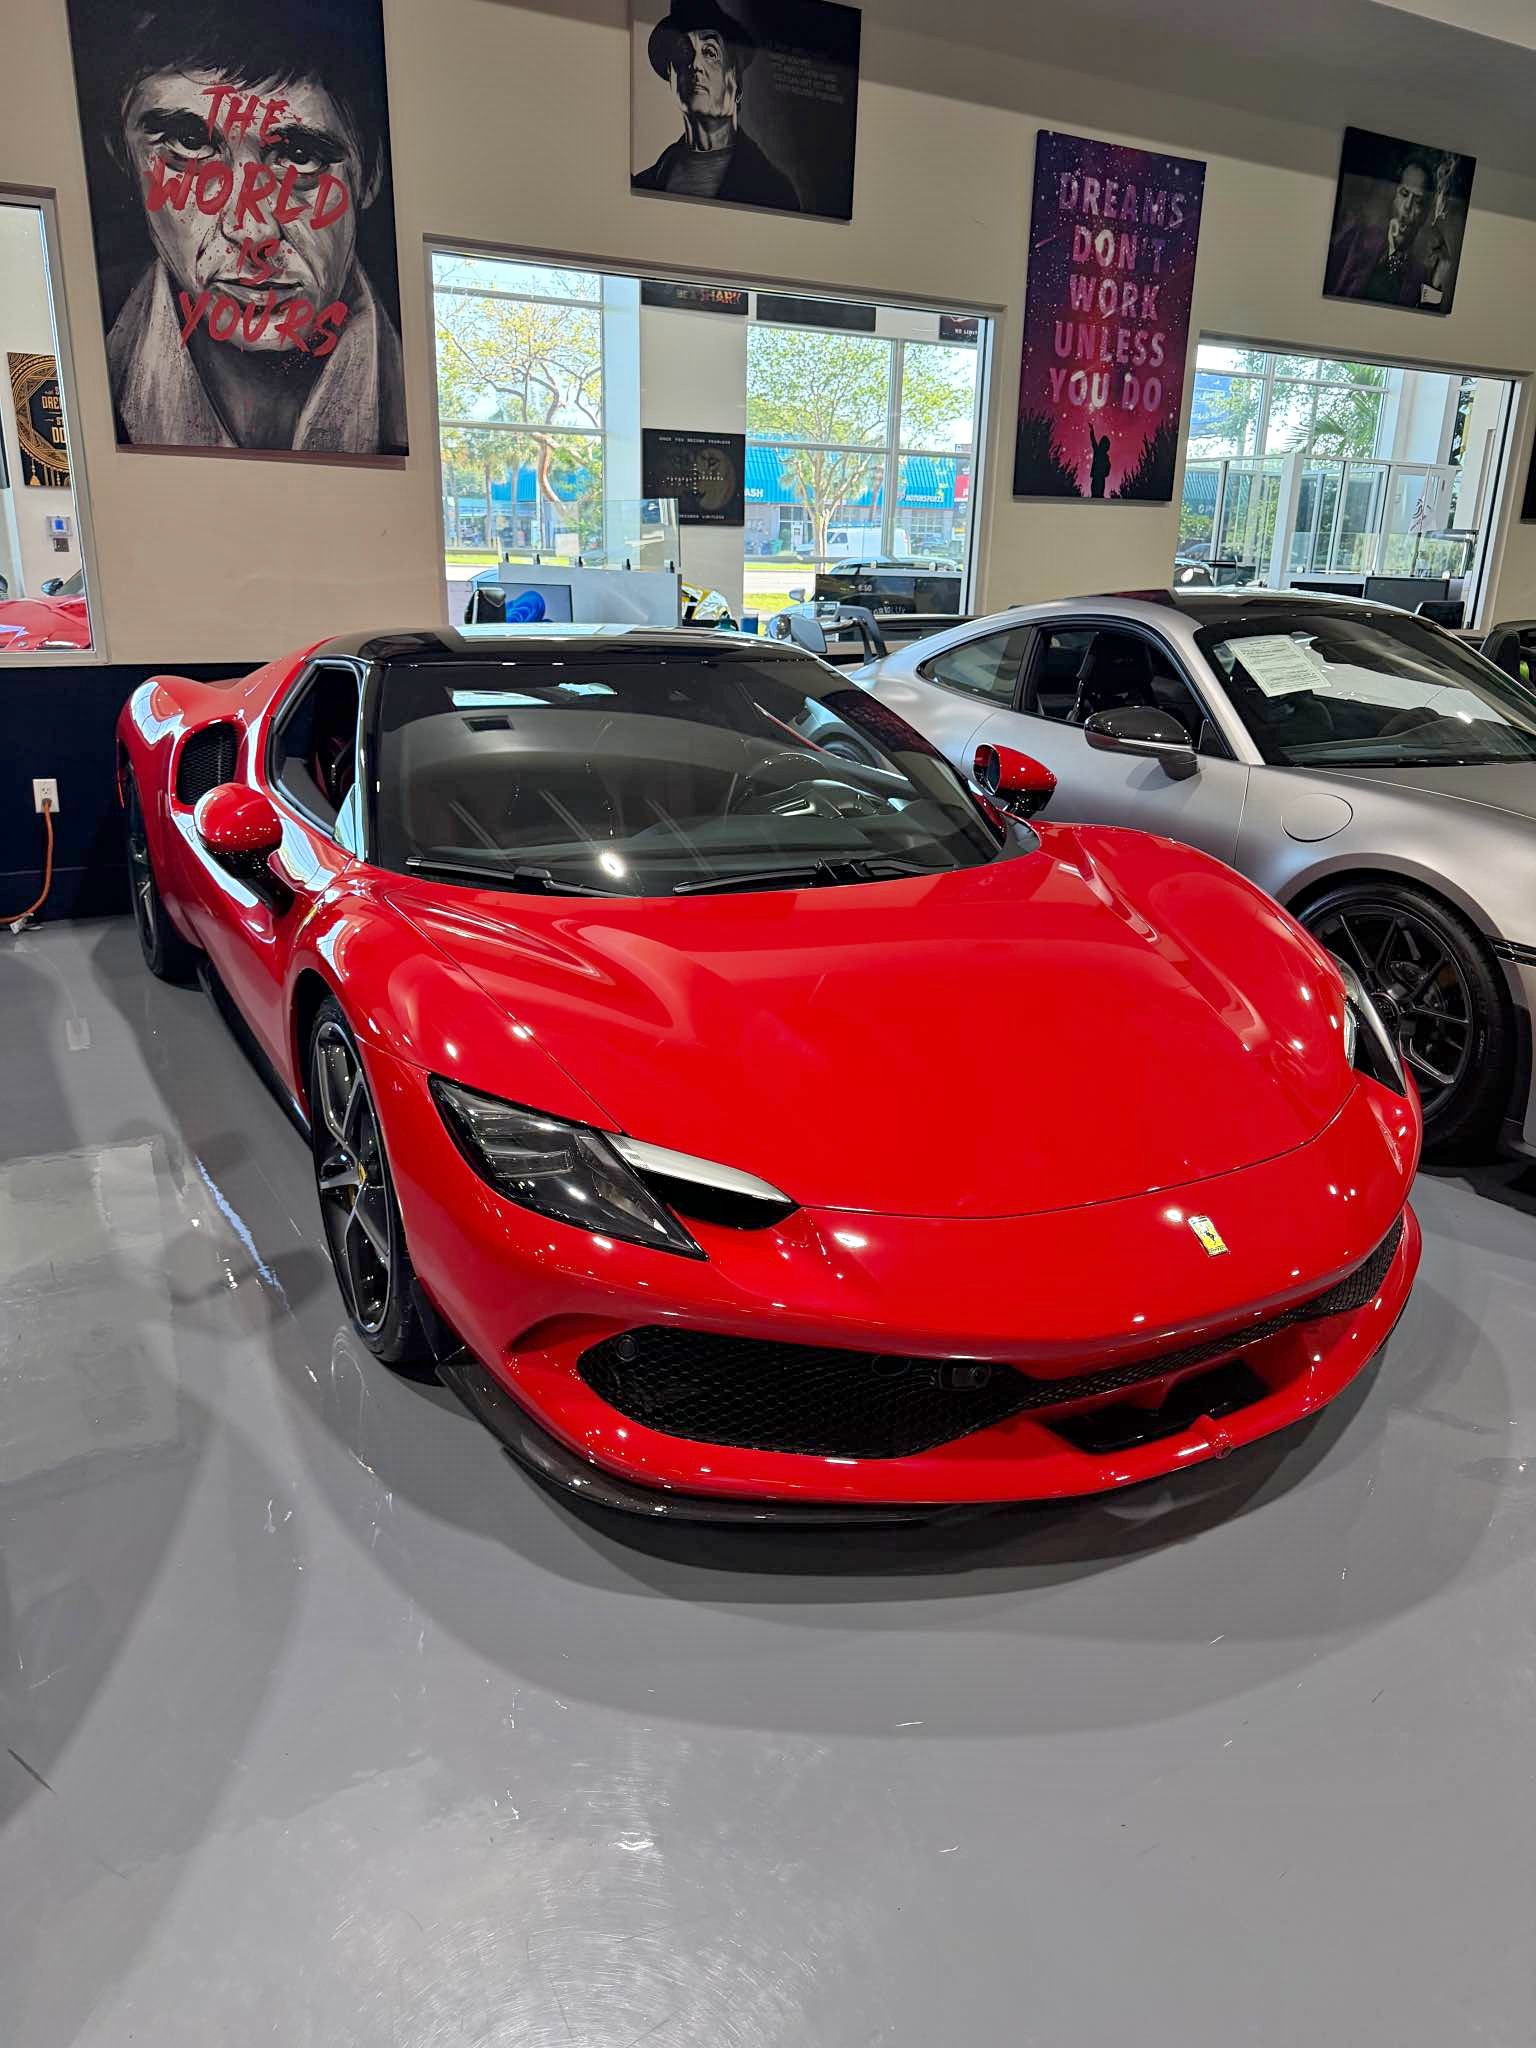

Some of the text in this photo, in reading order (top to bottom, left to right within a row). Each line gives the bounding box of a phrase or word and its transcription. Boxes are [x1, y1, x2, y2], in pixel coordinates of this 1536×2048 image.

[202, 85, 290, 147] THE
[144, 155, 350, 231] WORLD
[1059, 171, 1186, 227] DREAMS
[236, 237, 283, 286] IS
[1069, 273, 1160, 321] WORK
[179, 290, 350, 358] YOURS
[1054, 320, 1166, 368] UNLESS
[1049, 367, 1162, 412] YOU DO
